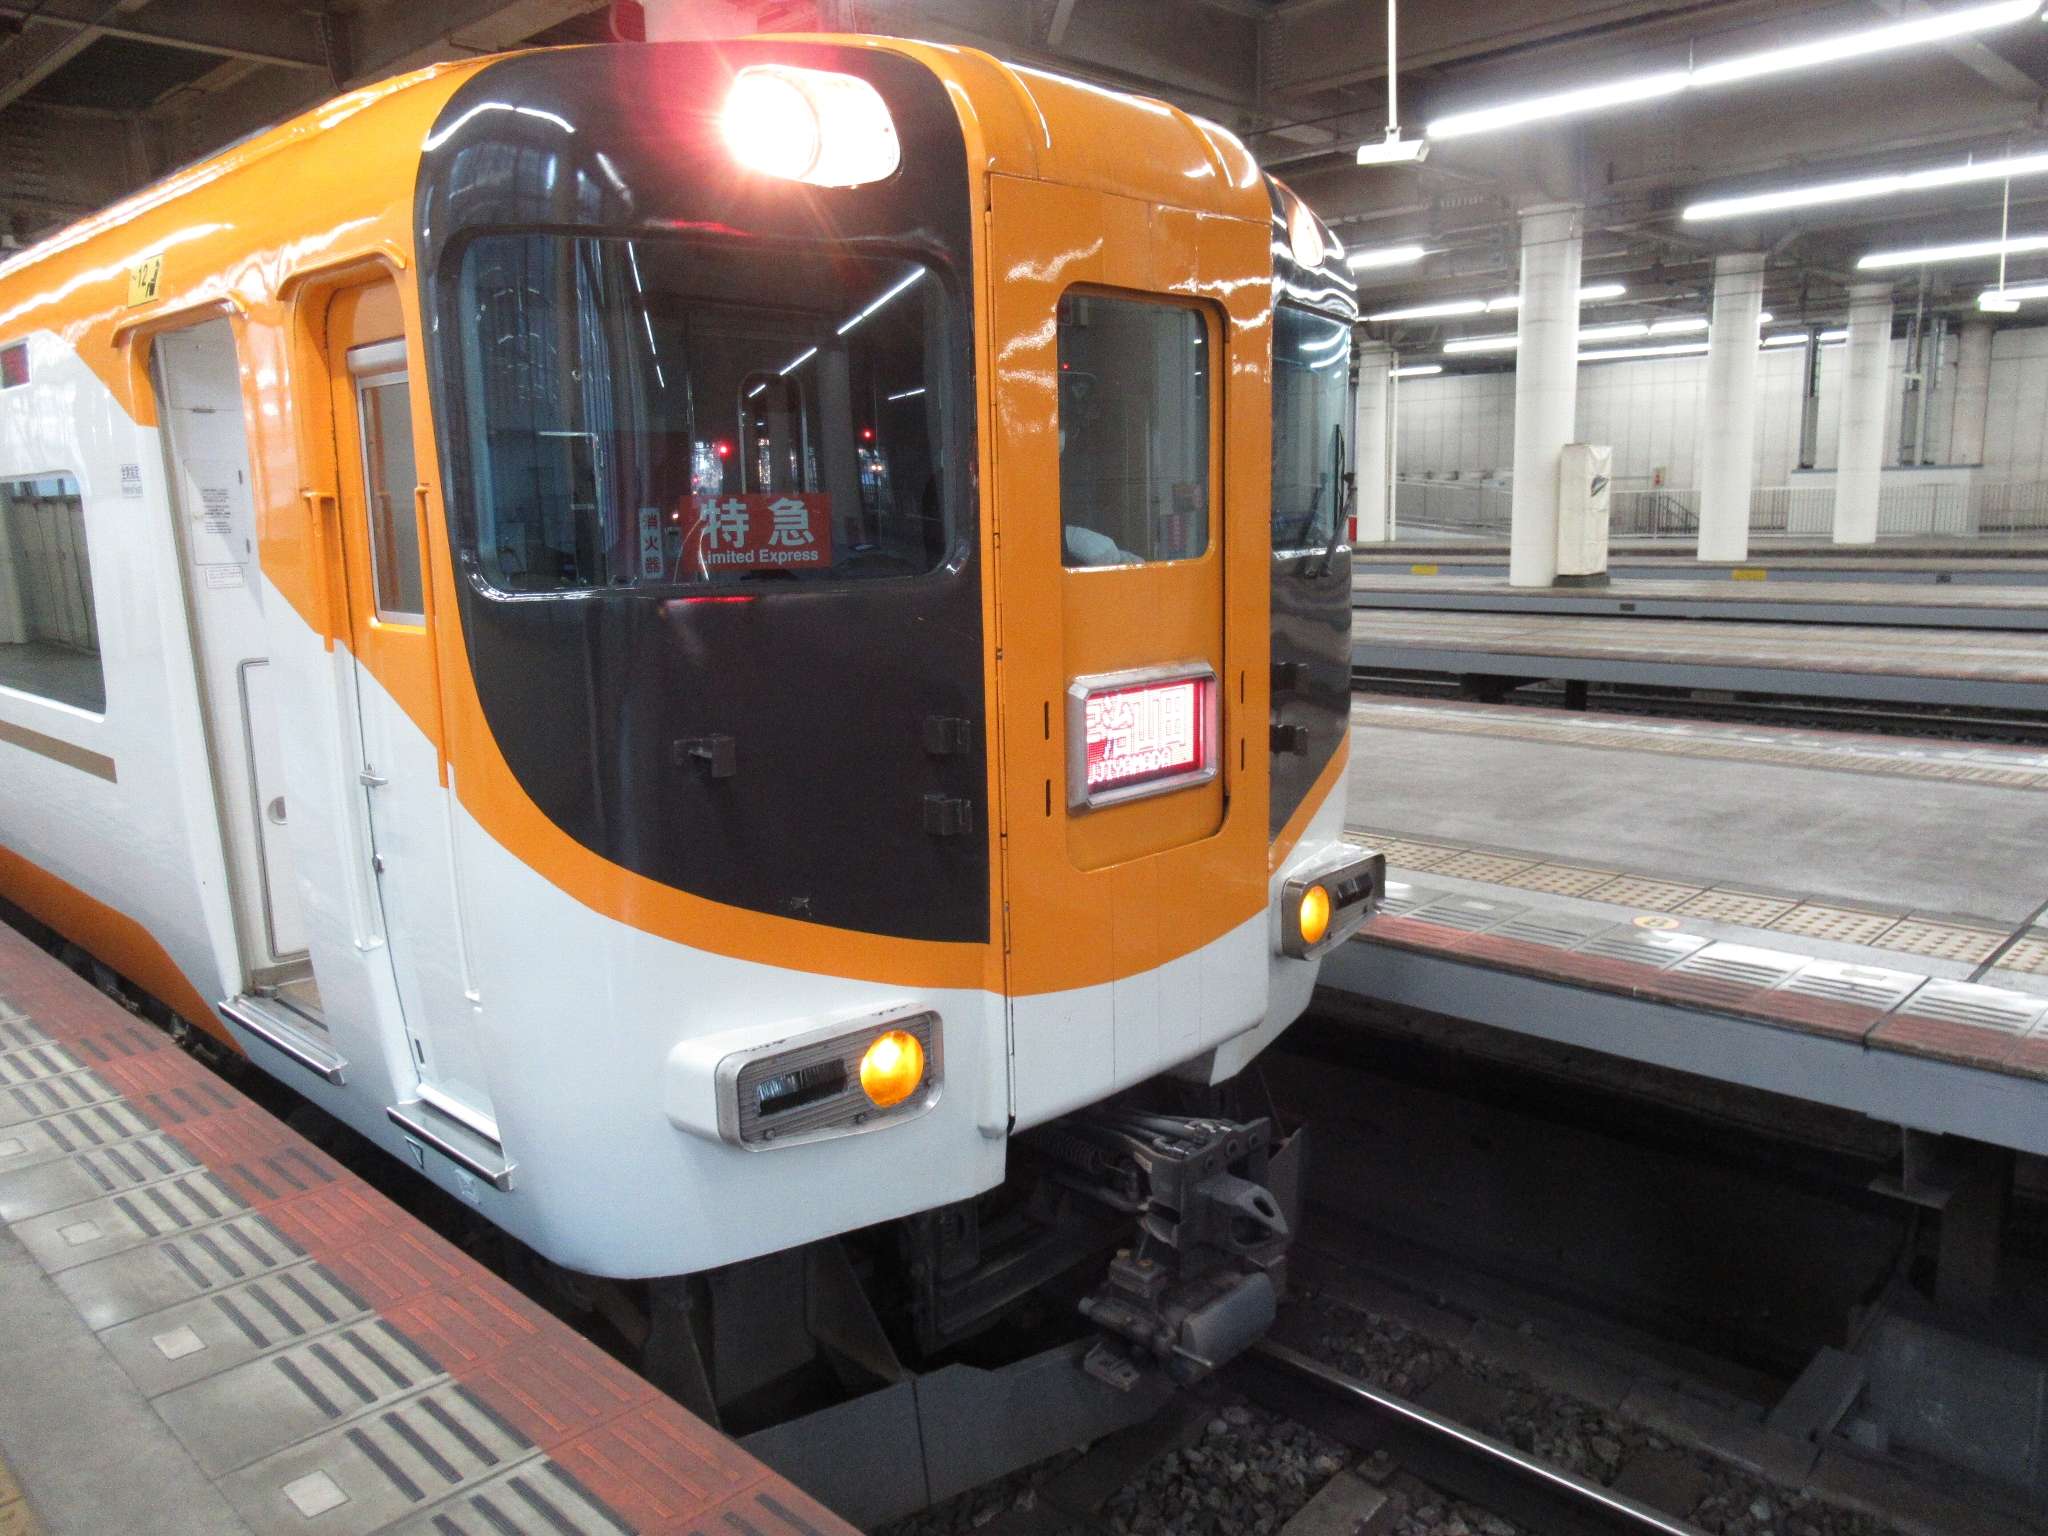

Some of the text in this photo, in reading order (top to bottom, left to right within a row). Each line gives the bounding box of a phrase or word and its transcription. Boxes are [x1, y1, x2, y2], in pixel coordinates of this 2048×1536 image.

[700, 497, 815, 549] 特急
[698, 549, 819, 565] Limited Express
